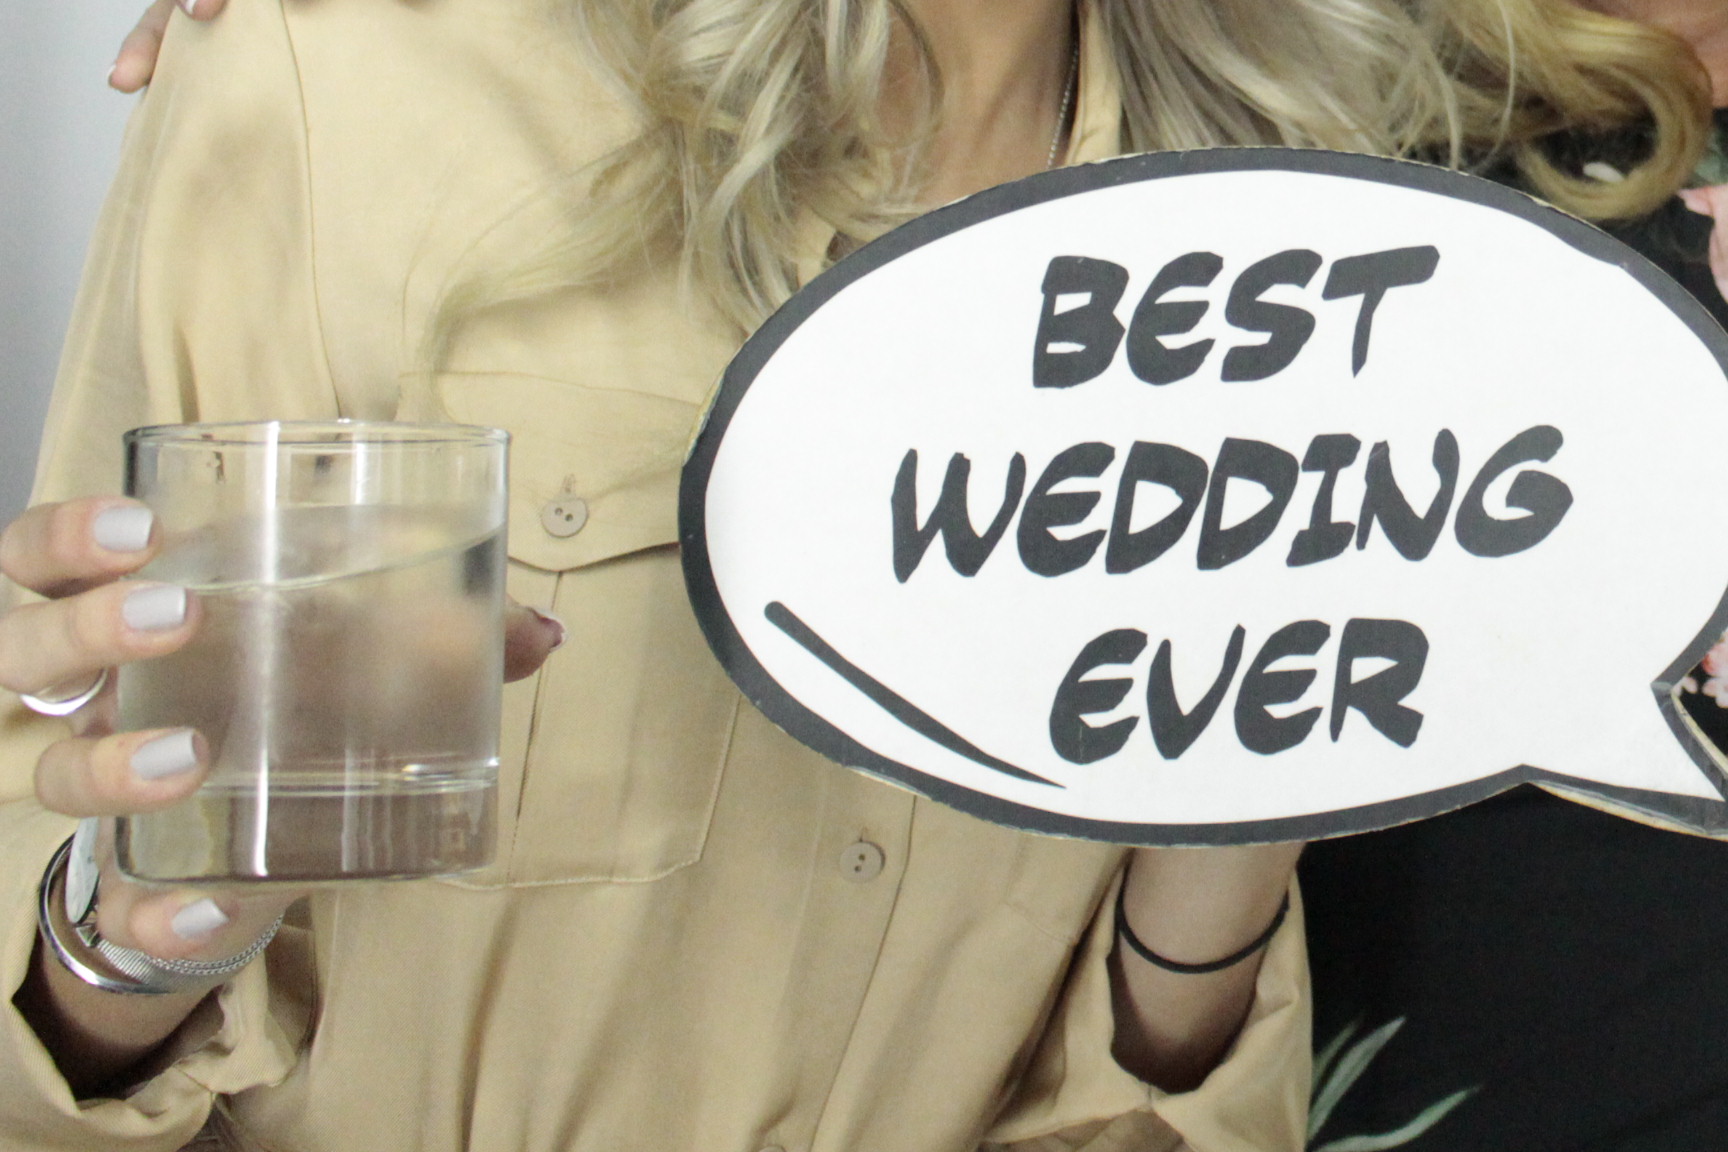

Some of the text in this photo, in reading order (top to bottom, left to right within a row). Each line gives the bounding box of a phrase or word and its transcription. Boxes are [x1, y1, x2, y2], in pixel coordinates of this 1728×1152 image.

[1034, 246, 1439, 388] BEST
[892, 426, 1572, 582] WEDDING
[1050, 619, 1428, 764] EVER
